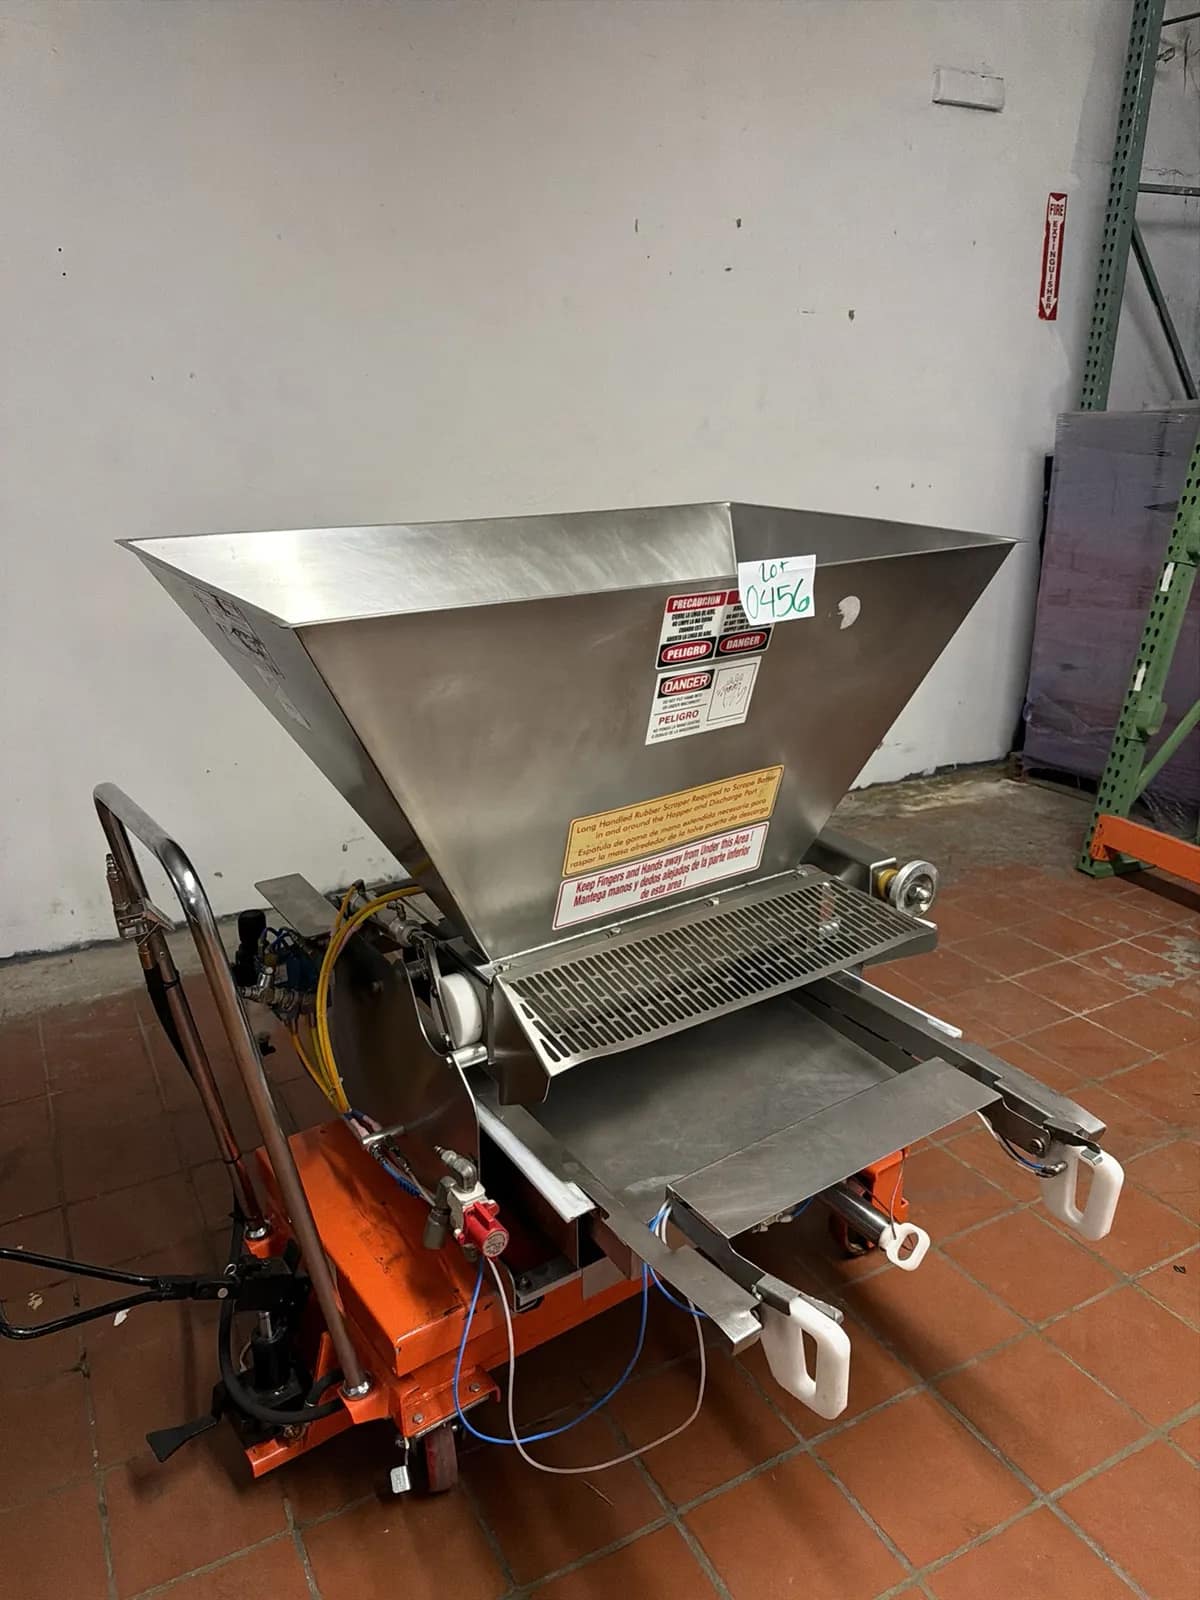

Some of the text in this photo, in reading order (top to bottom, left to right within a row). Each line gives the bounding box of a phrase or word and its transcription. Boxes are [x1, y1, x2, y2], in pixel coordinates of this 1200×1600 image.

[1050, 203, 1064, 216] FIRE
[1045, 220, 1059, 309] EXTINGUISHER
[672, 595, 721, 610] PRECAUCION
[746, 578, 810, 620] 0456
[667, 644, 707, 660] PELIGRO
[726, 635, 760, 650] DANGER
[664, 676, 708, 692] DANGER
[658, 710, 699, 725] PELIGRO
[577, 824, 596, 834] Long
[599, 813, 632, 828] Handled
[635, 806, 661, 819] Rubber
[663, 798, 690, 812] Scraper
[692, 787, 722, 802] Required
[733, 780, 755, 792] Scrape
[605, 828, 620, 837] and
[623, 820, 650, 832] around
[653, 815, 664, 824] the
[666, 806, 692, 820] Hopper
[694, 800, 708, 811] and
[709, 792, 742, 807] Discharge
[630, 837, 664, 851] alrededor
[728, 814, 737, 822] de
[614, 839, 624, 847] de
[576, 880, 596, 893] Keep
[597, 872, 625, 887] Fingers
[625, 866, 640, 879] and
[641, 860, 664, 875] Hands
[664, 855, 683, 867] away
[683, 848, 700, 860] from
[700, 842, 719, 855] Under
[721, 837, 734, 849] this
[734, 834, 750, 845] Area
[574, 846, 751, 907] Mantega manos y dedos alejados de la parte inferior
[640, 890, 649, 899] de
[651, 885, 665, 896] esta
[667, 880, 682, 891] area
